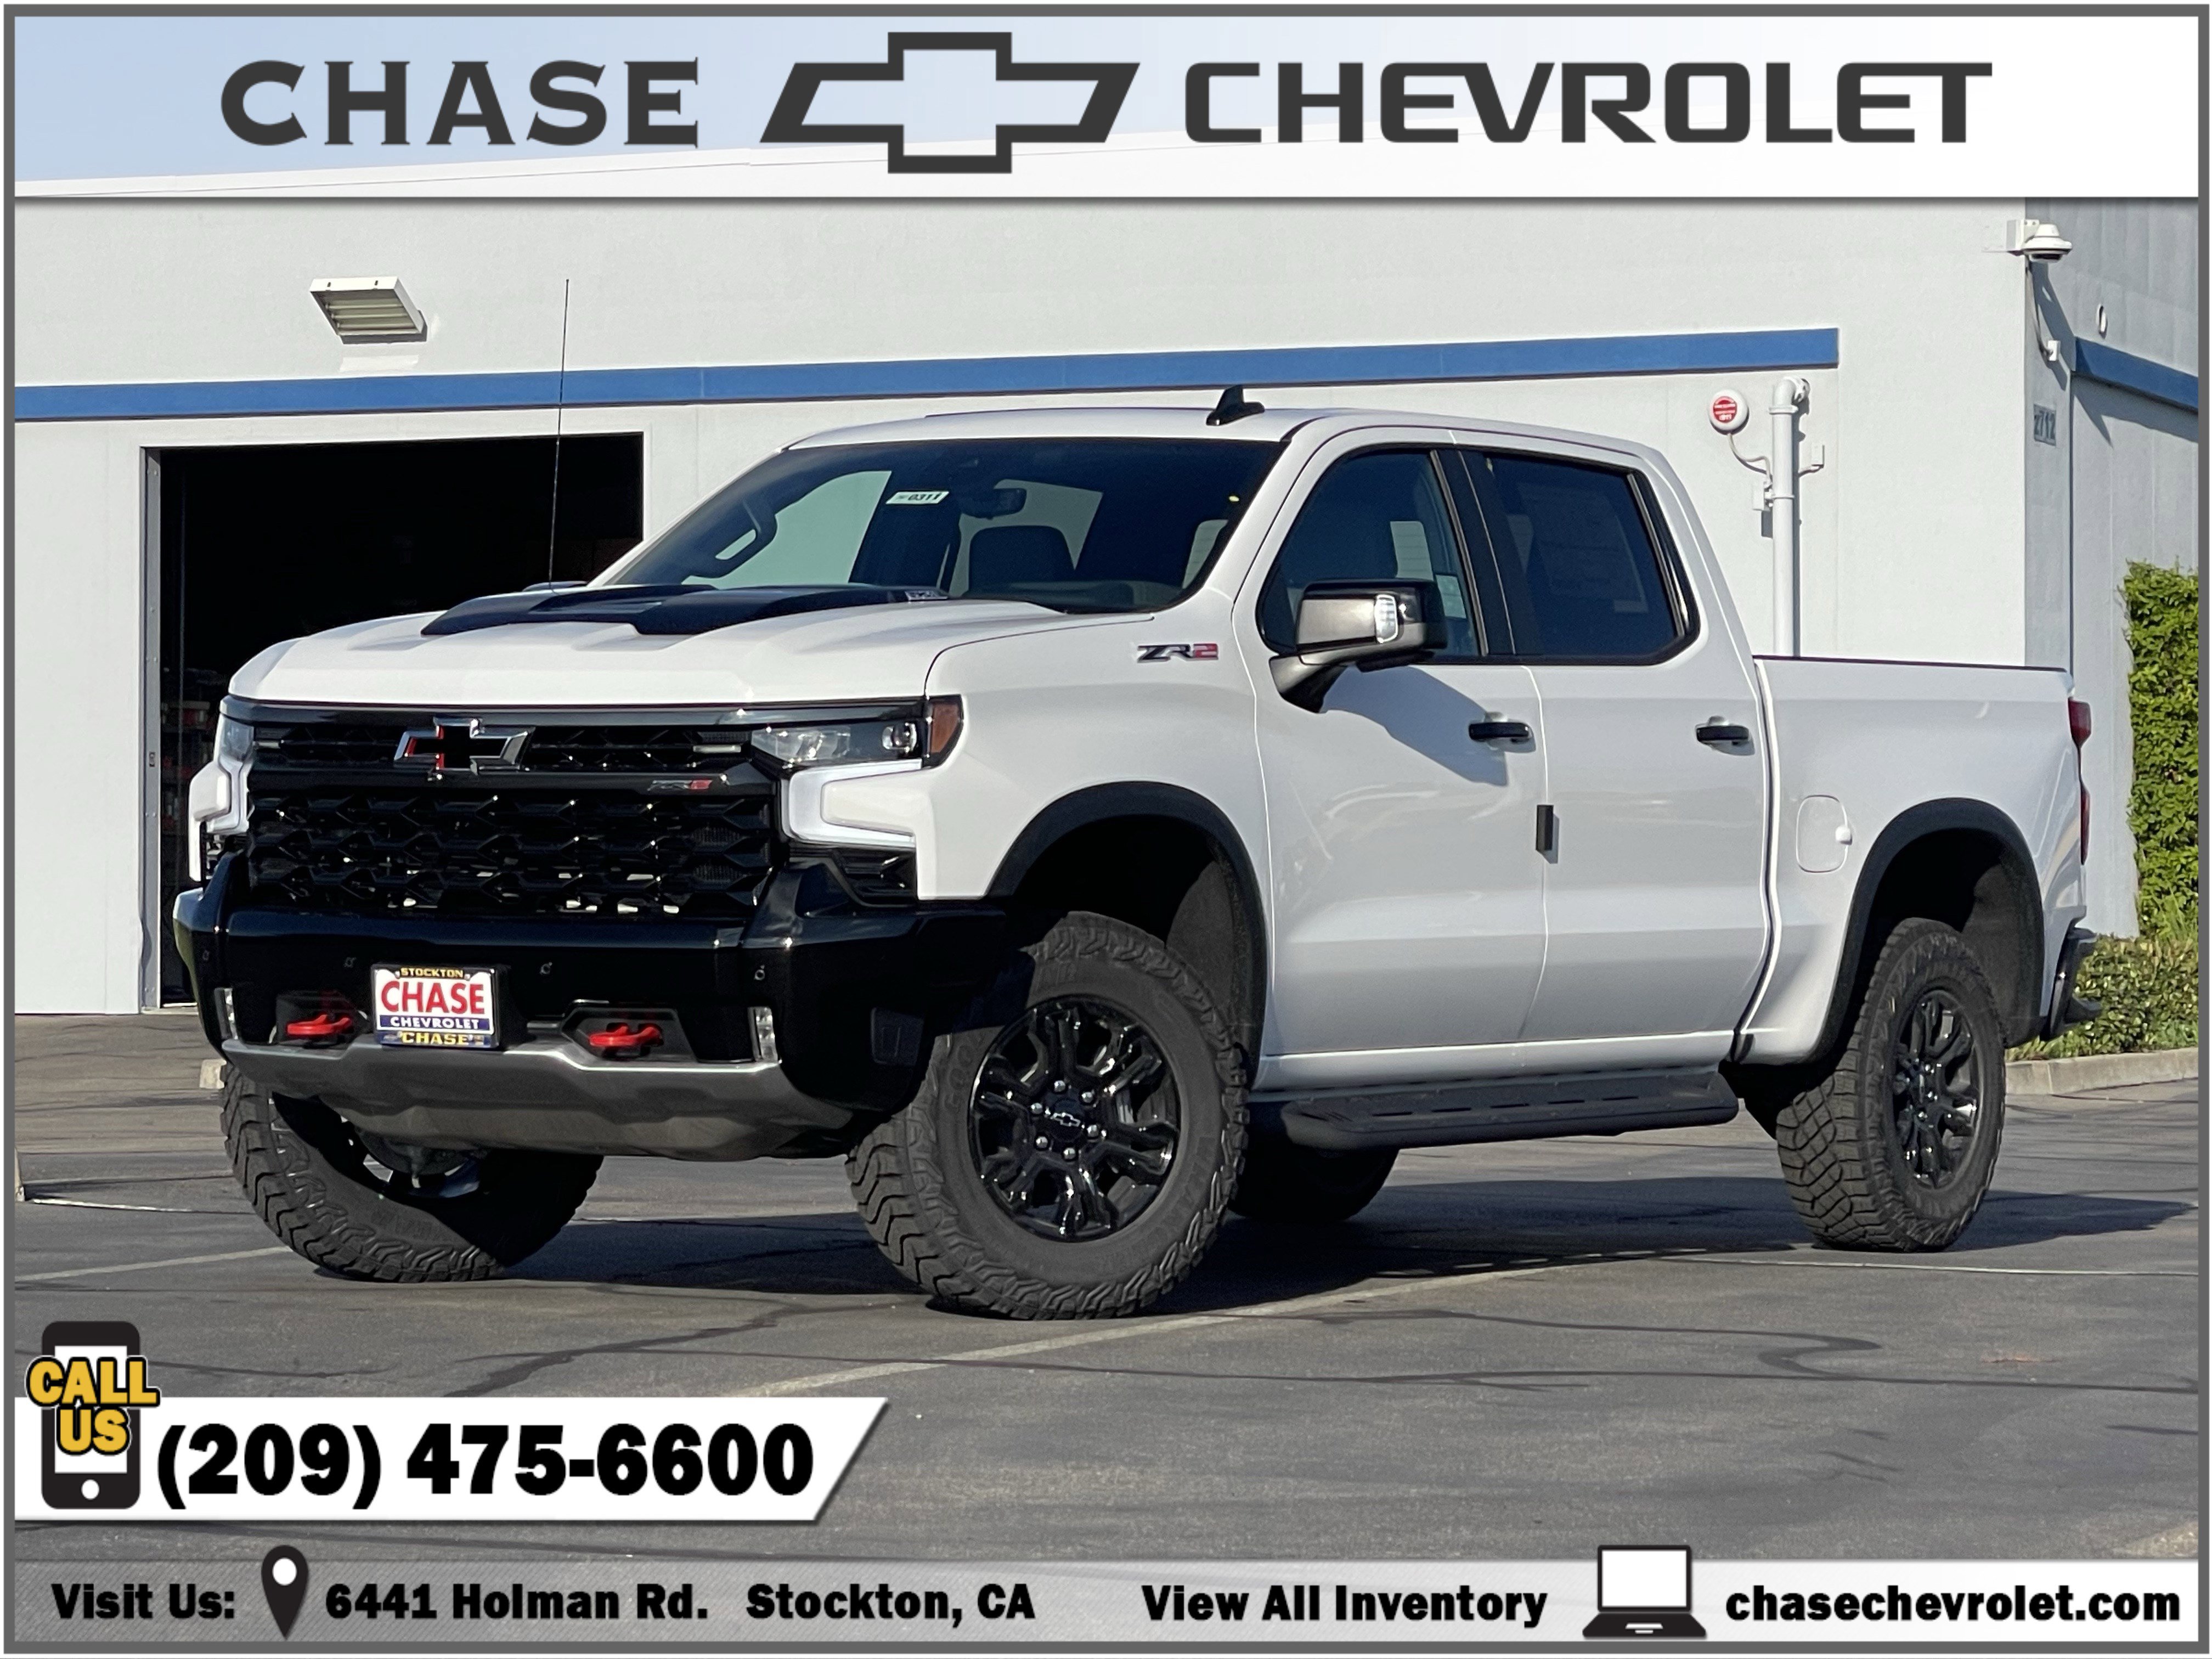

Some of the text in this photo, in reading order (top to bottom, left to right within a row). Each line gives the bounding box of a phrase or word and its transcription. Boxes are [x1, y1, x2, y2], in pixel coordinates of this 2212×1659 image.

[1137, 644, 1218, 663] ZR2
[401, 968, 463, 978] STOCKTON
[381, 981, 484, 1014] CHASE
[390, 1017, 479, 1029] CHEVROLET
